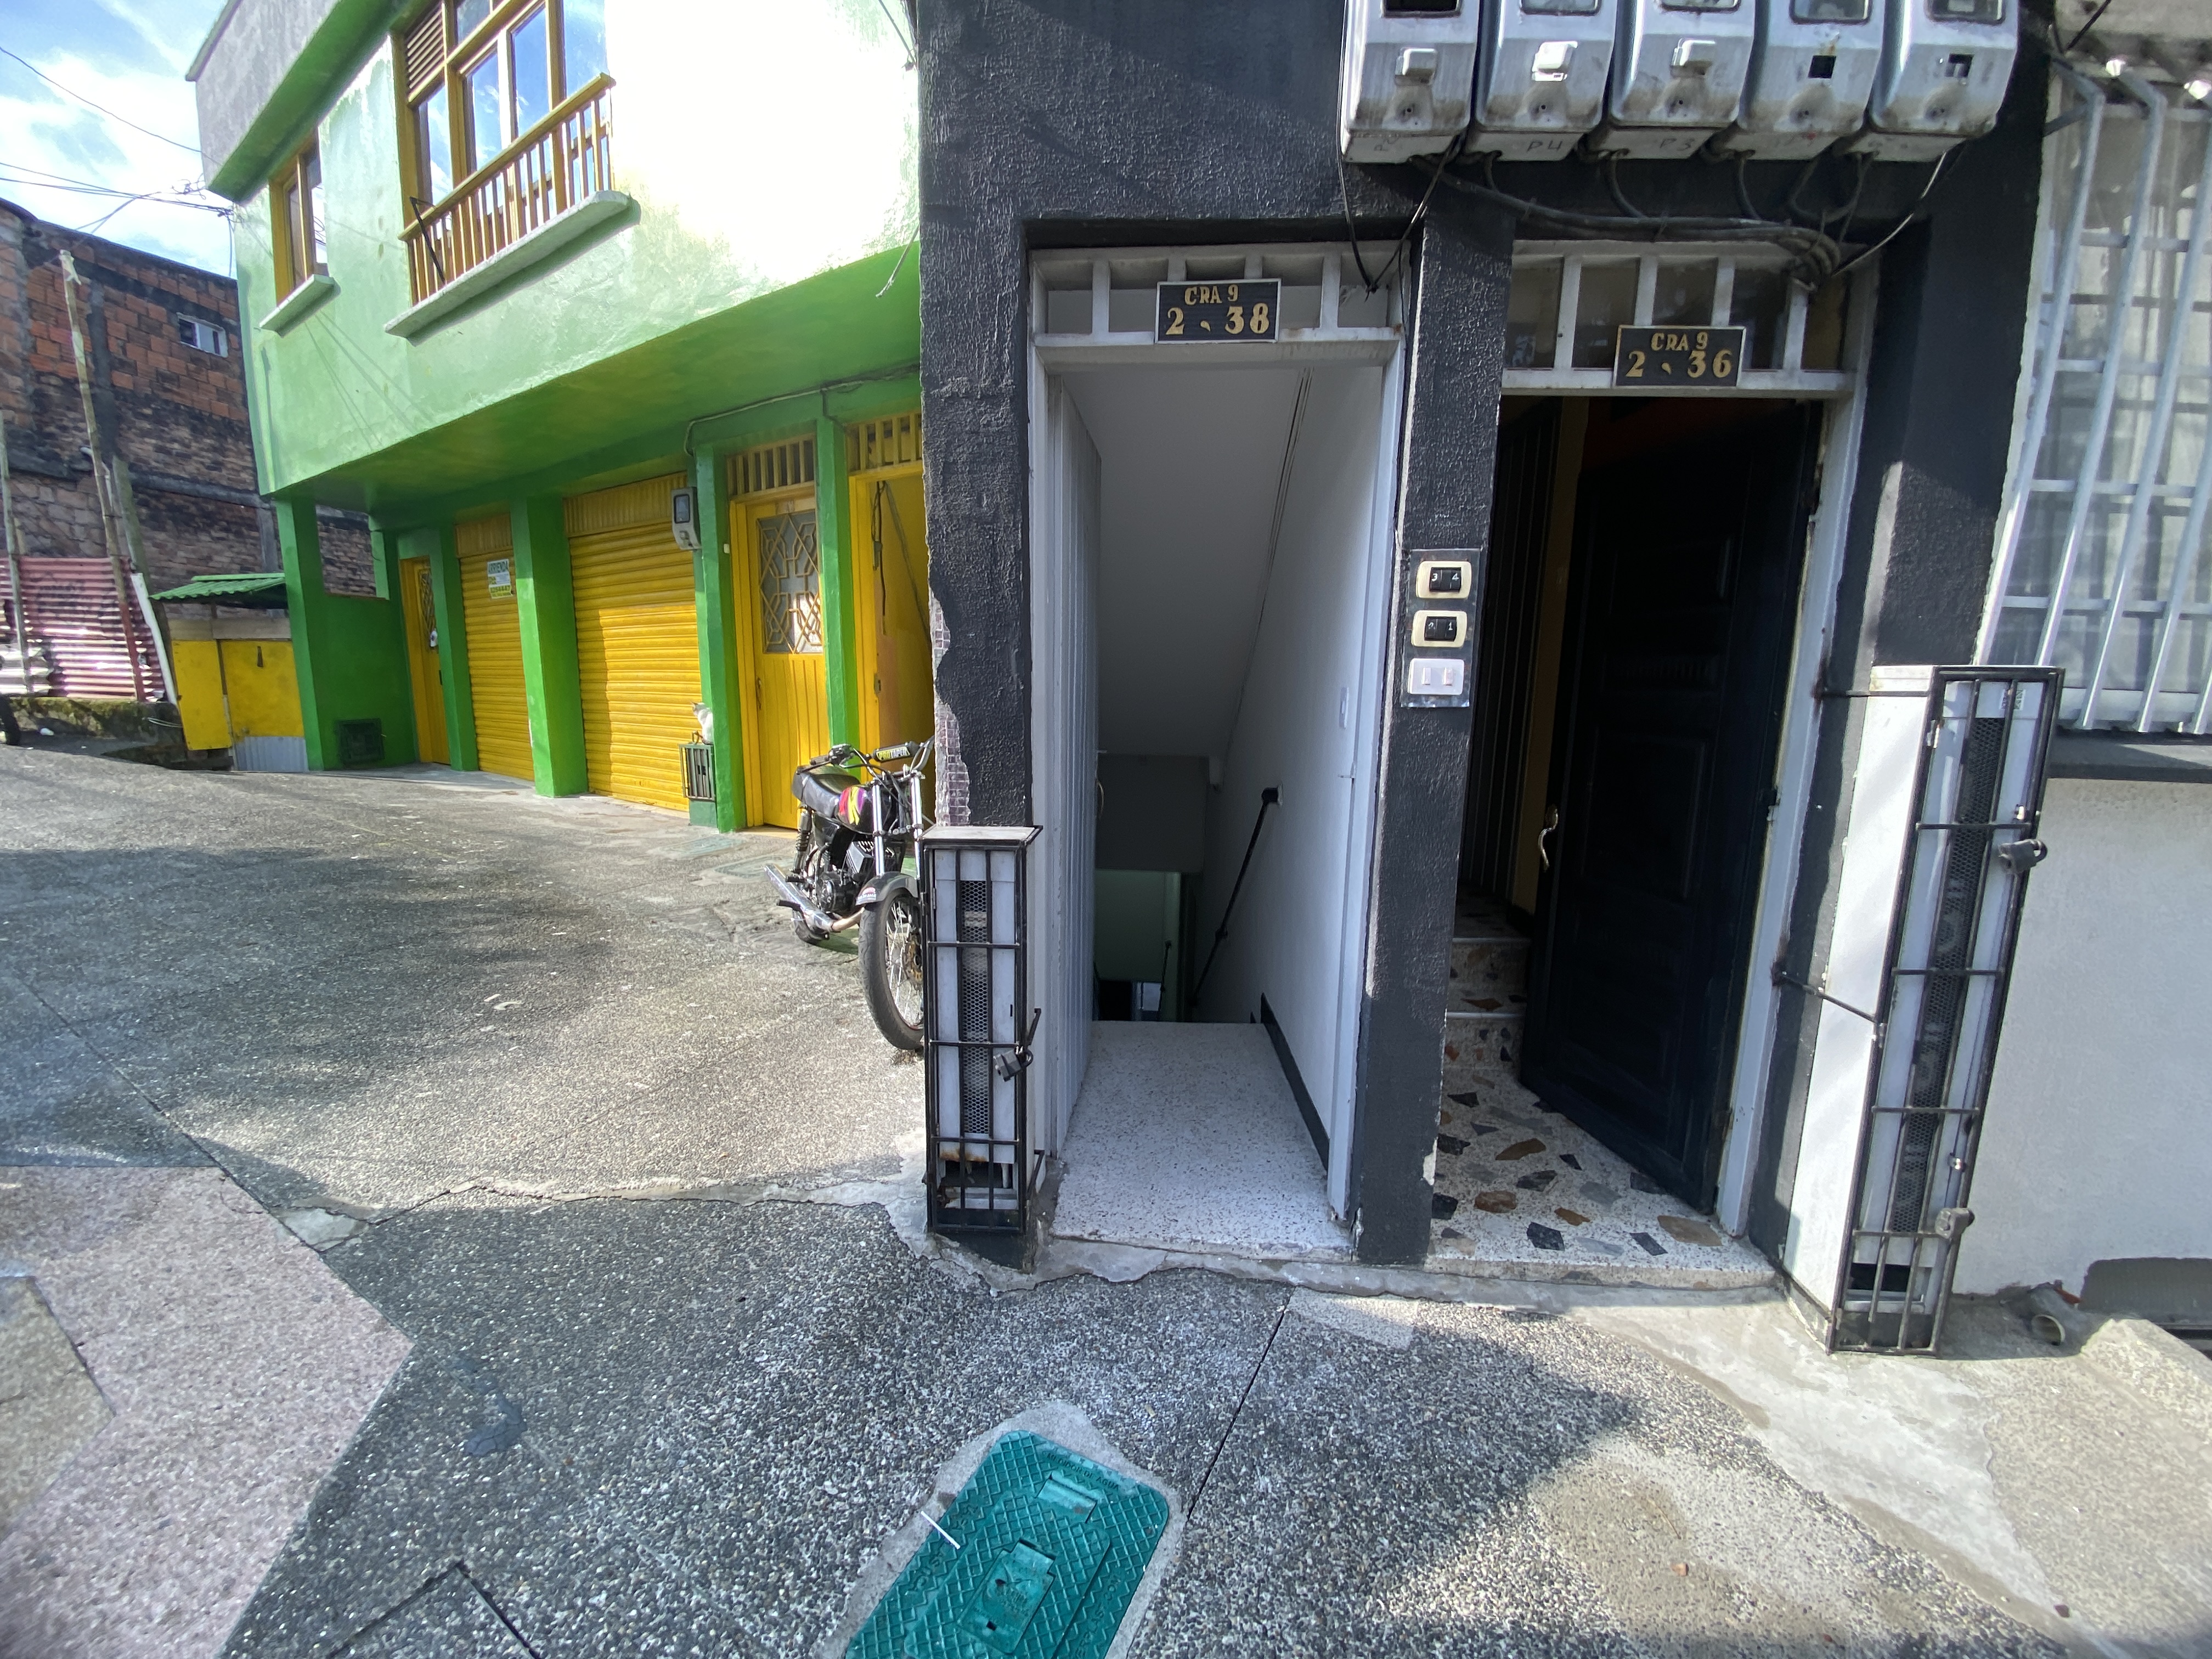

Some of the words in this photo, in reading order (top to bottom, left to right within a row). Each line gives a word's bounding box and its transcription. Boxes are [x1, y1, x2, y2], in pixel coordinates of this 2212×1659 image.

[1184, 286, 1222, 305] CRA
[1228, 284, 1239, 302] 9
[1651, 332, 1689, 351] CRA
[1696, 331, 1708, 349] 9
[1431, 573, 1438, 582] 3
[1452, 573, 1459, 582] 4
[1448, 622, 1453, 630] 1
[878, 748, 907, 759] PROTAPER
[1096, 1476, 1120, 1492] AGUA
